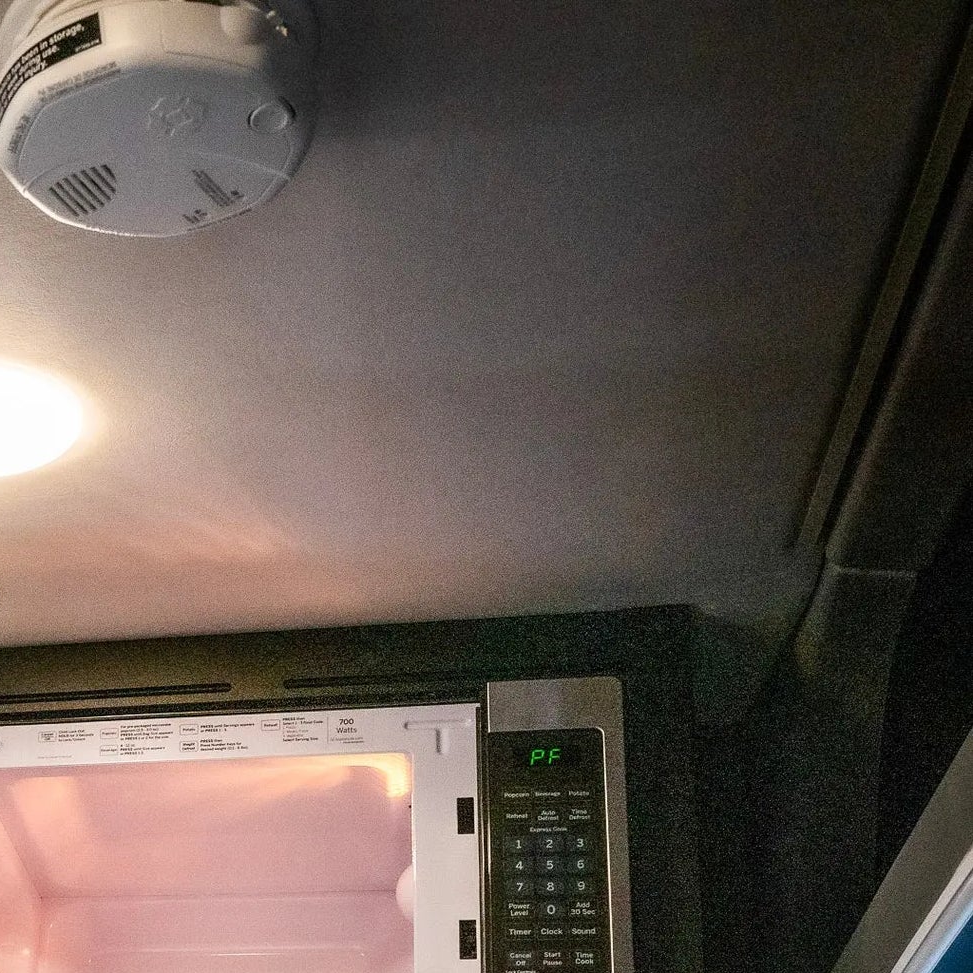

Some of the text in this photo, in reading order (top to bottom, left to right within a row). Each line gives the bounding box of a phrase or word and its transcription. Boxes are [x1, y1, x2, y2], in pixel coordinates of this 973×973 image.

[21, 46, 39, 64] been
[39, 41, 48, 51] in
[49, 23, 85, 46] storage,
[530, 748, 561, 766] PF
[516, 840, 522, 849] 1
[546, 840, 554, 849] 2
[576, 838, 584, 848] 3
[515, 860, 524, 870] 4
[546, 860, 554, 870] 5
[576, 860, 585, 869] 6
[516, 882, 524, 892] 7
[546, 882, 555, 891] 8
[577, 881, 586, 890] 9
[546, 904, 556, 914] 0
